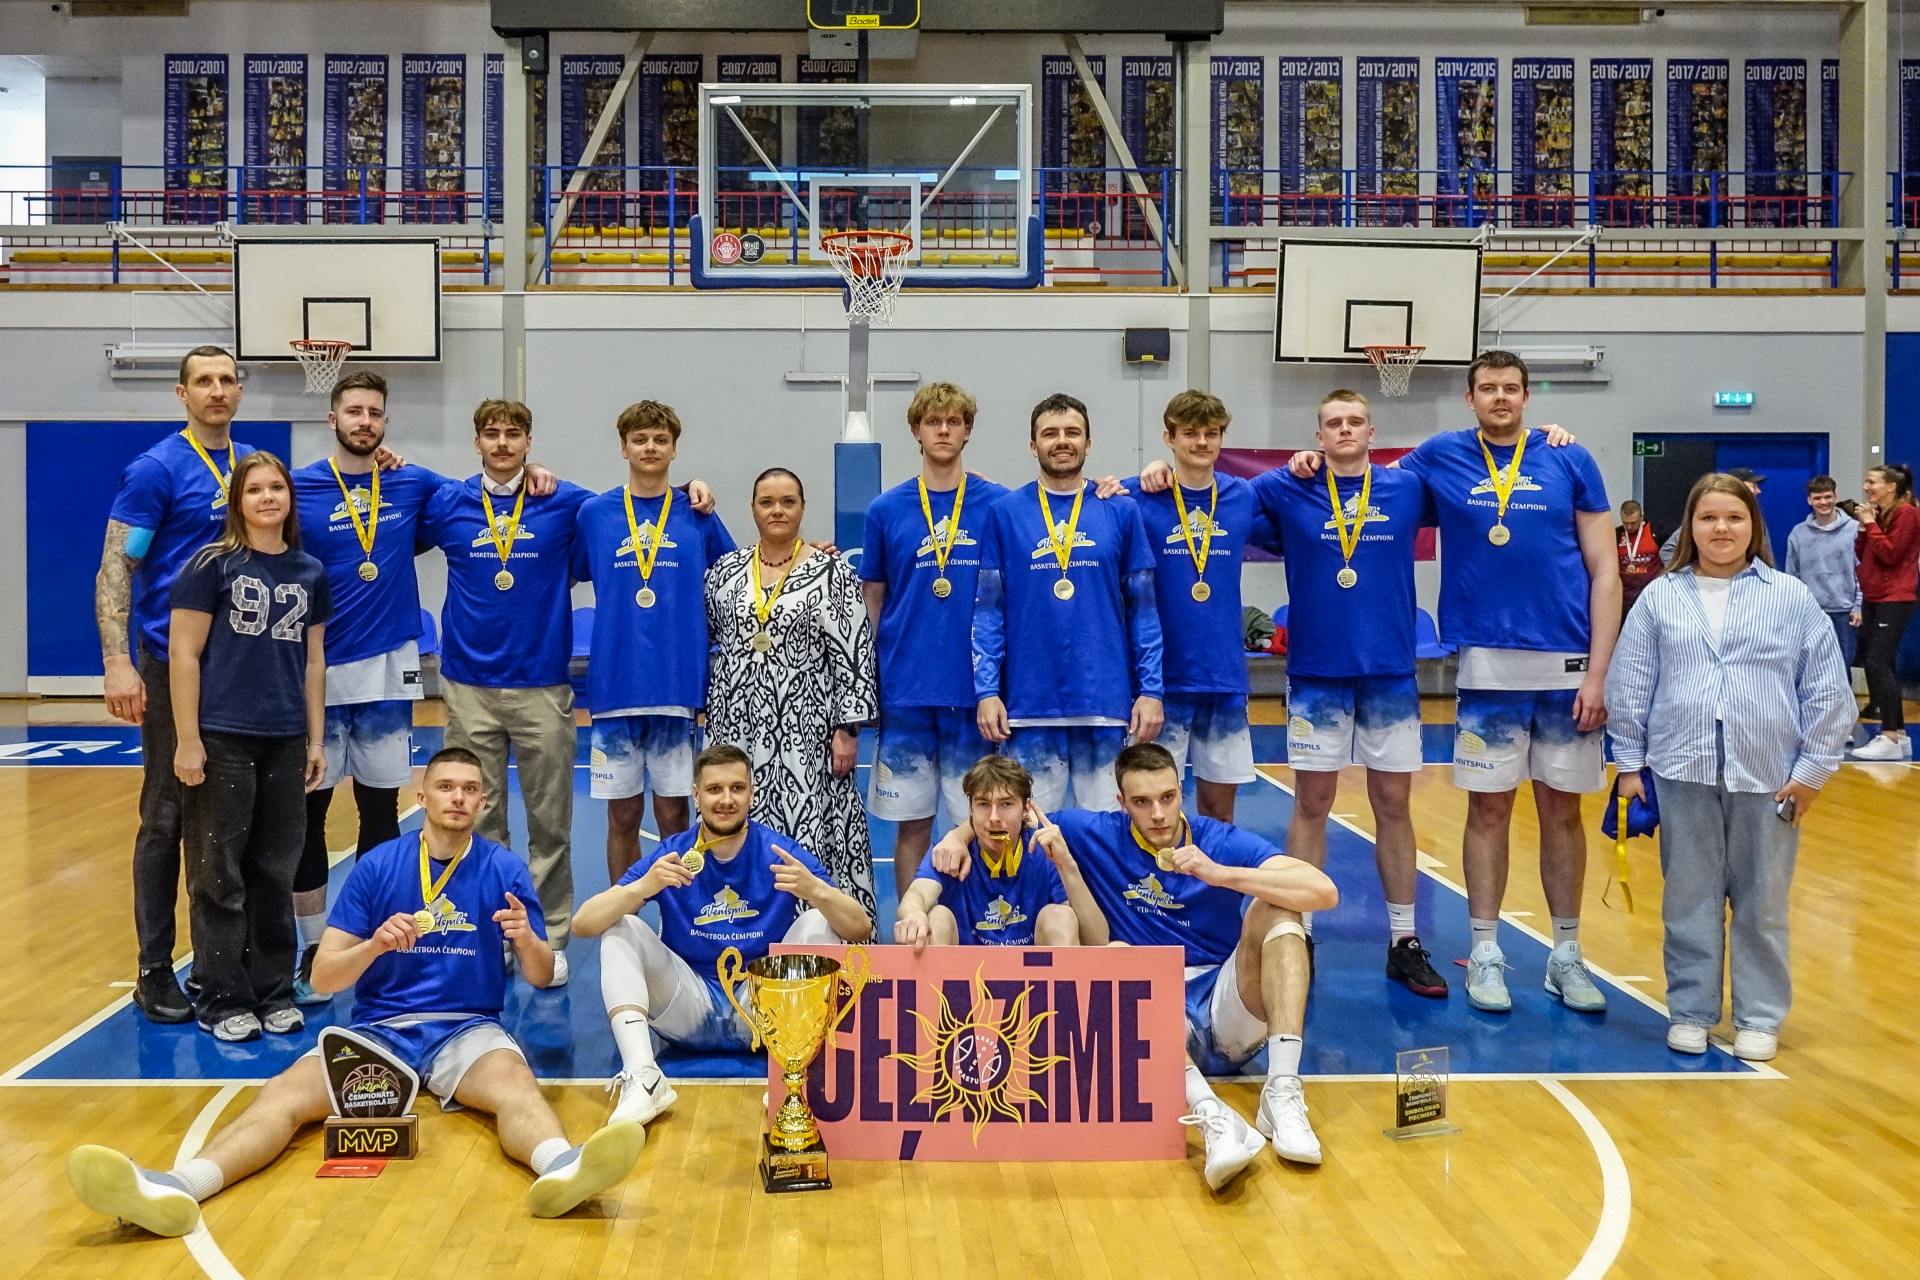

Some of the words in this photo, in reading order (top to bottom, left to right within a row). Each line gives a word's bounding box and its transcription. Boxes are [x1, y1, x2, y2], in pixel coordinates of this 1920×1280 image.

[168, 60, 225, 75] 2000/2001
[248, 60, 304, 74] 2001/2002
[327, 61, 385, 75] 2002/2003
[405, 60, 463, 74] 2003/2004
[563, 61, 622, 75] 2005/2006
[642, 61, 699, 74] 2006/2007
[722, 62, 777, 75] 2007/2008
[801, 60, 856, 73] 2008/2009
[1046, 61, 1103, 75] 2009/10
[1126, 62, 1171, 76] 2010/20
[1211, 62, 1260, 76] 011/2012
[1282, 62, 1339, 76] 2012/2013
[1359, 63, 1418, 77] 2013/2014
[1437, 62, 1496, 77] 2014/2015
[1514, 64, 1573, 79] 2015/2016
[1592, 64, 1651, 79] 2016/2017
[1669, 65, 1728, 80] 2017/2018
[1746, 66, 1805, 80] 2018/2019
[1362, 534, 1394, 542] ČEMPIONI
[951, 557, 980, 566] ČEMPIONI
[229, 574, 308, 642] 92
[1288, 742, 1321, 750] ENTSPILS
[1455, 757, 1494, 769] VENTSPILS
[690, 929, 730, 940] BASKETBOLA
[731, 931, 764, 940] ČEMPIONI
[442, 945, 476, 956] ČEMPIONI
[975, 1035, 1000, 1054] KRASTS
[968, 1046, 987, 1072] PRET
[338, 1128, 398, 1153] MVP
